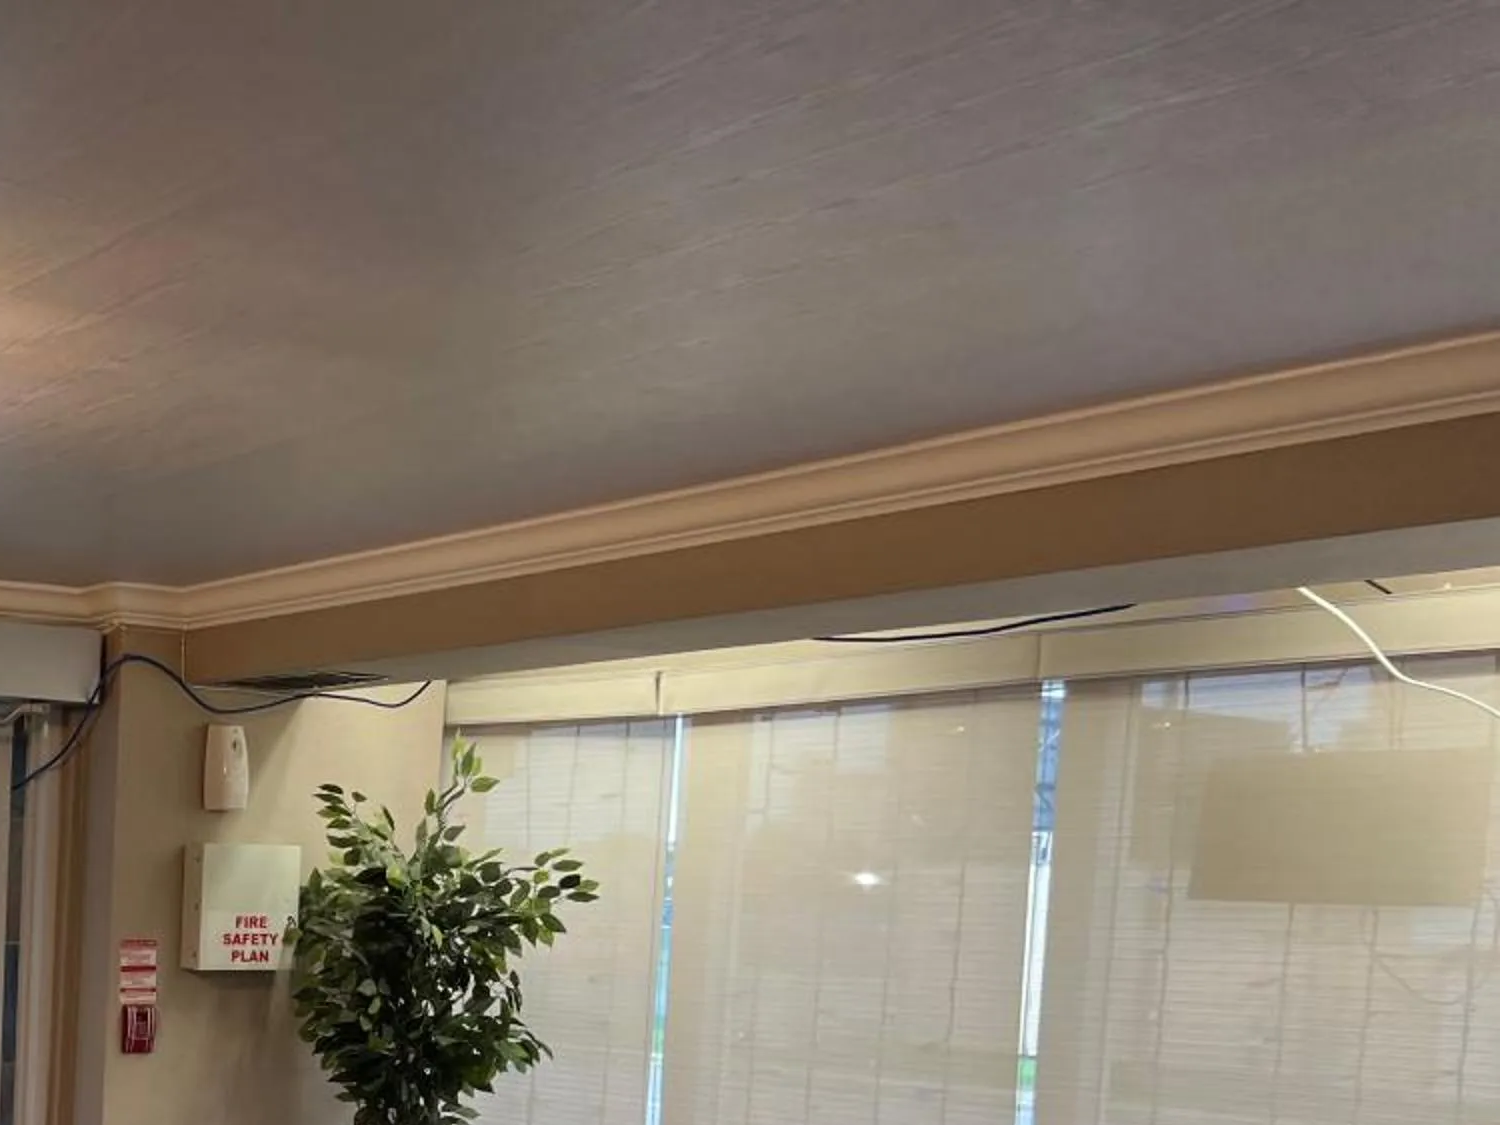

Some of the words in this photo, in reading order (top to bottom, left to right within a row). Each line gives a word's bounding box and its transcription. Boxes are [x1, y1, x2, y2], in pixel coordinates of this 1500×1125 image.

[235, 915, 268, 929] FIRE
[222, 932, 279, 946] SAFETY
[231, 949, 269, 963] PLAN
